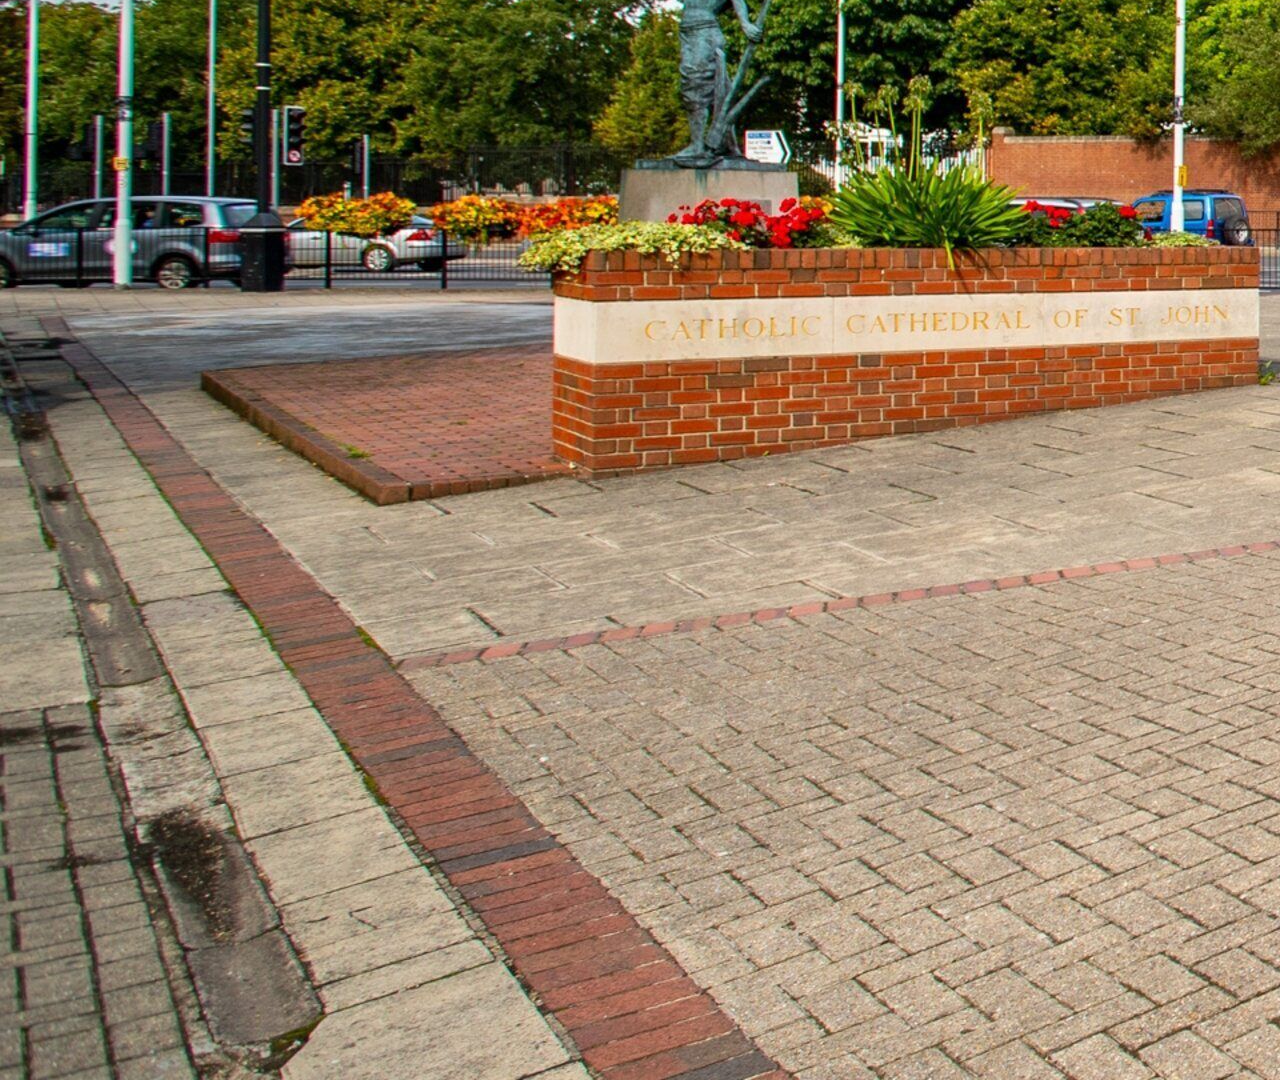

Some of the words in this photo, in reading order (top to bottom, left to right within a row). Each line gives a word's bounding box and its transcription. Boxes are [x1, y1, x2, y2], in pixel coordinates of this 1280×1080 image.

[644, 315, 821, 341] CATHOLIC
[845, 309, 1031, 335] CATHEDRAL
[1053, 308, 1088, 328] OF
[1108, 306, 1143, 328] ST.
[1160, 304, 1229, 326] JOHN
